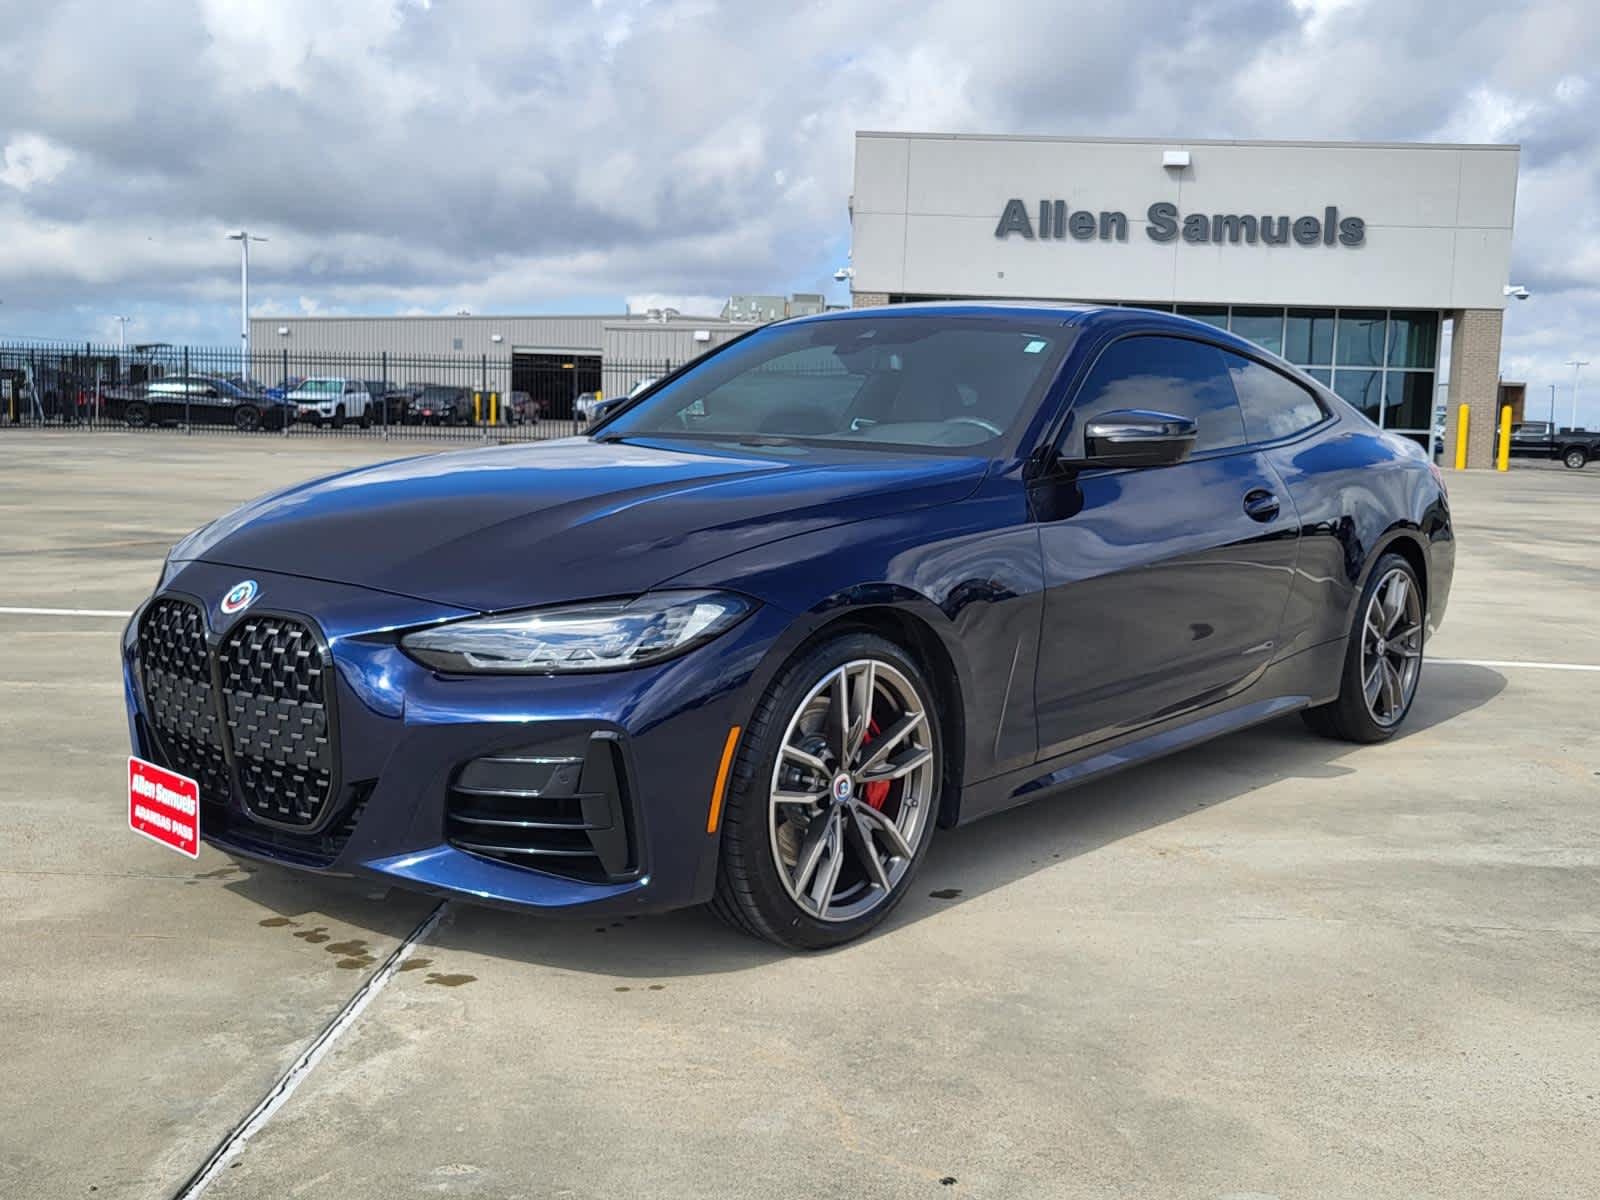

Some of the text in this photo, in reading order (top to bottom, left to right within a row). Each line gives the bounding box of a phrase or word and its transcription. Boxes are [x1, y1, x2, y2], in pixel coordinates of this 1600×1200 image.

[995, 199, 1365, 246] Allen Samuels
[132, 774, 195, 816] Allen Samuels
